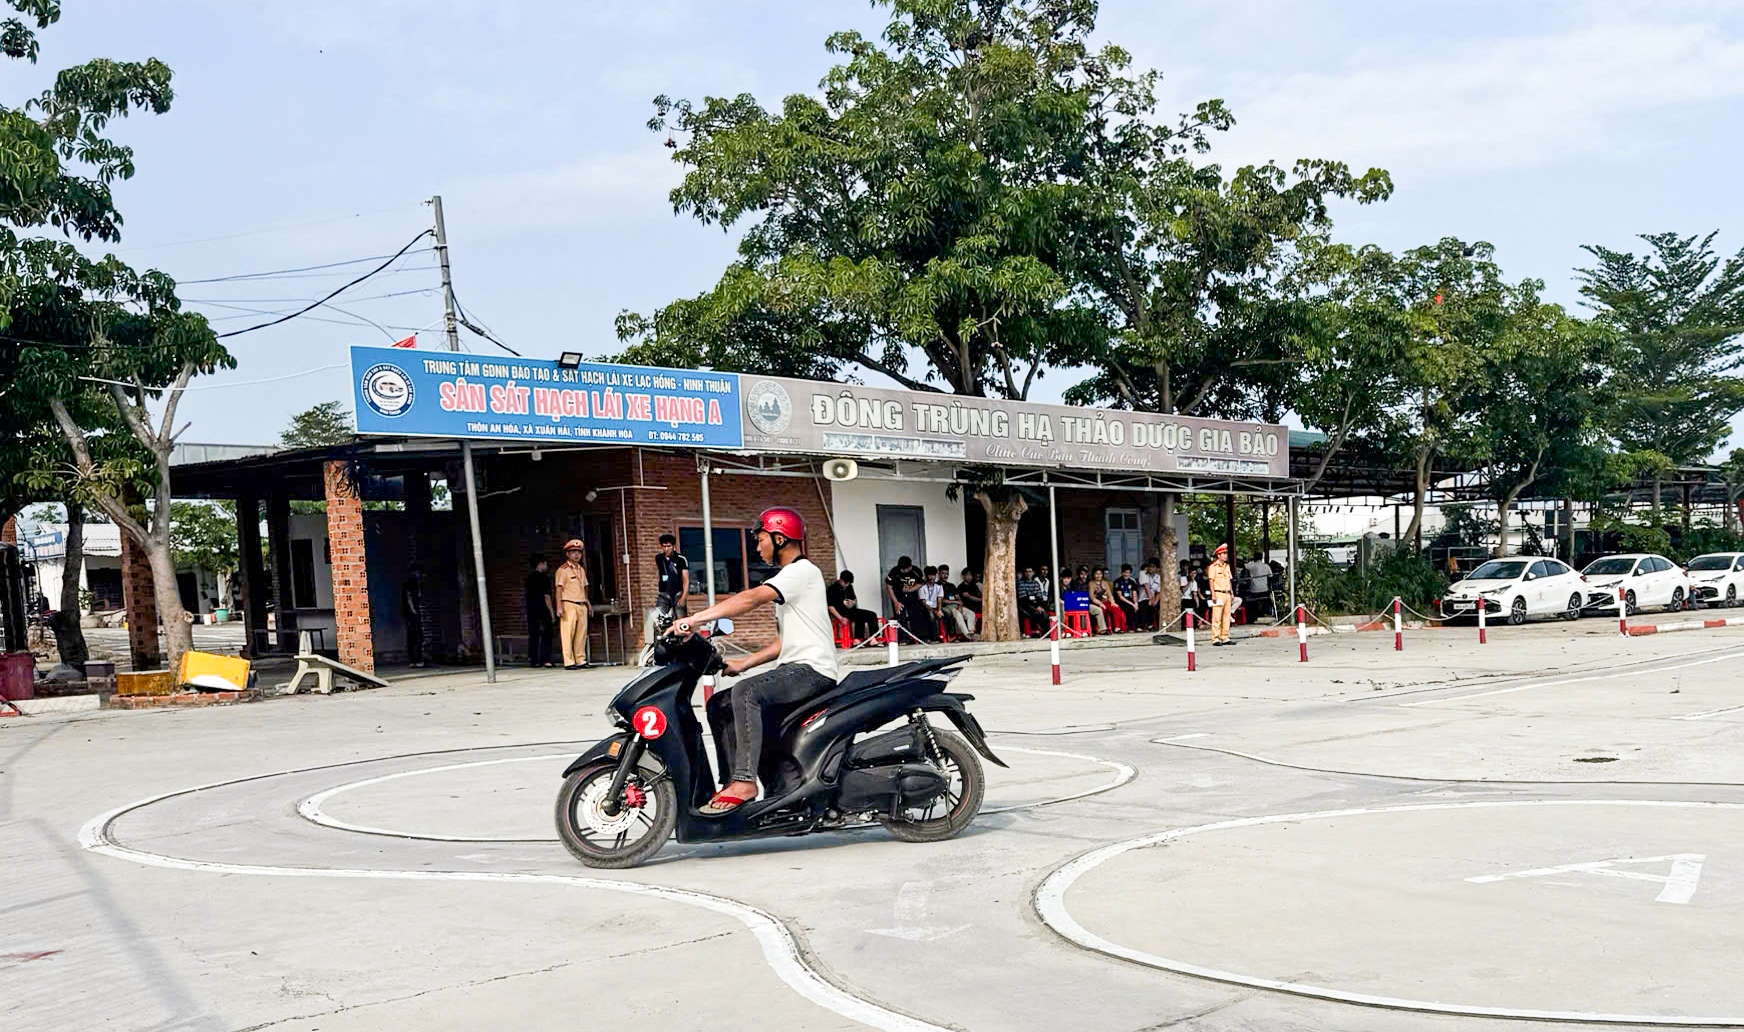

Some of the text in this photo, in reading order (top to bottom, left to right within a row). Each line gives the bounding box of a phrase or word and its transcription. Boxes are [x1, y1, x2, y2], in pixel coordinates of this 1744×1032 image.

[423, 359, 457, 375] TRUNG
[459, 360, 480, 376] TÂM
[482, 363, 509, 378] GDNN
[511, 364, 531, 379] ĐÀO
[532, 367, 550, 384] TẠO
[552, 369, 560, 382] &
[581, 371, 605, 387] HẠCH
[606, 370, 620, 386] LÁI
[622, 374, 633, 387] XE
[635, 374, 651, 391] LẠC
[683, 378, 703, 392] NINH
[705, 378, 731, 396] THUẬN
[440, 377, 487, 413] SÂN
[489, 380, 531, 415] SÁT
[533, 386, 589, 422] HẠCH
[592, 386, 624, 420] LÁI
[625, 393, 652, 421] XE
[654, 394, 705, 429] HẠNG
[708, 398, 723, 426] A
[467, 422, 488, 432] THÔN
[490, 423, 502, 433] AN
[535, 424, 557, 436] XUÂN
[592, 426, 617, 438] KHÁNH
[811, 390, 1279, 457] ĐÔNG TRÙNG HẠ THẢO DƯỢC GIA BẢO
[642, 711, 659, 736] 2
